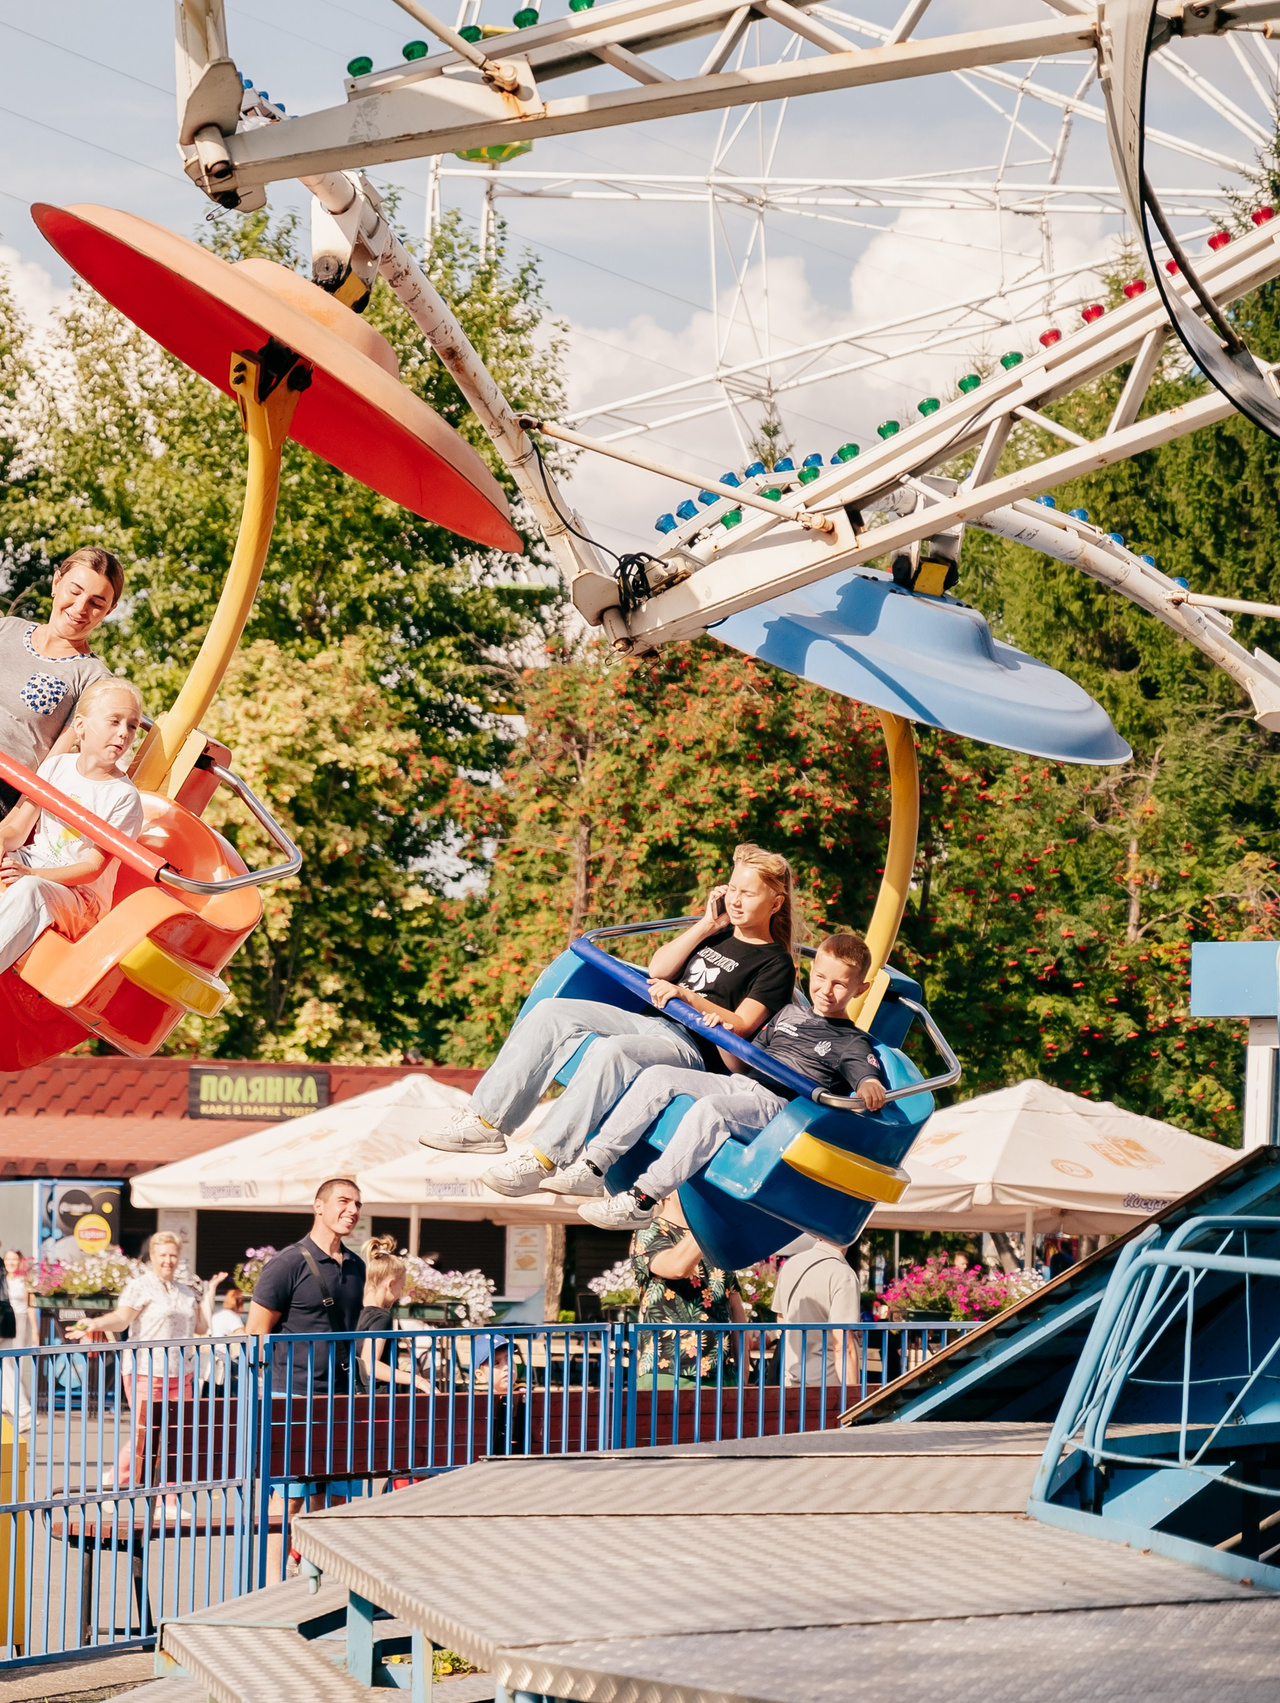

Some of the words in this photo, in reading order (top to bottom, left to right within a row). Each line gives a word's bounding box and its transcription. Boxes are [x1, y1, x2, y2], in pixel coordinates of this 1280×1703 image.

[199, 1075, 319, 1104] ПОЛЯНКА
[199, 1104, 231, 1116] КАФЕ
[232, 1105, 241, 1116] В
[242, 1105, 281, 1117] ПАРКЕ
